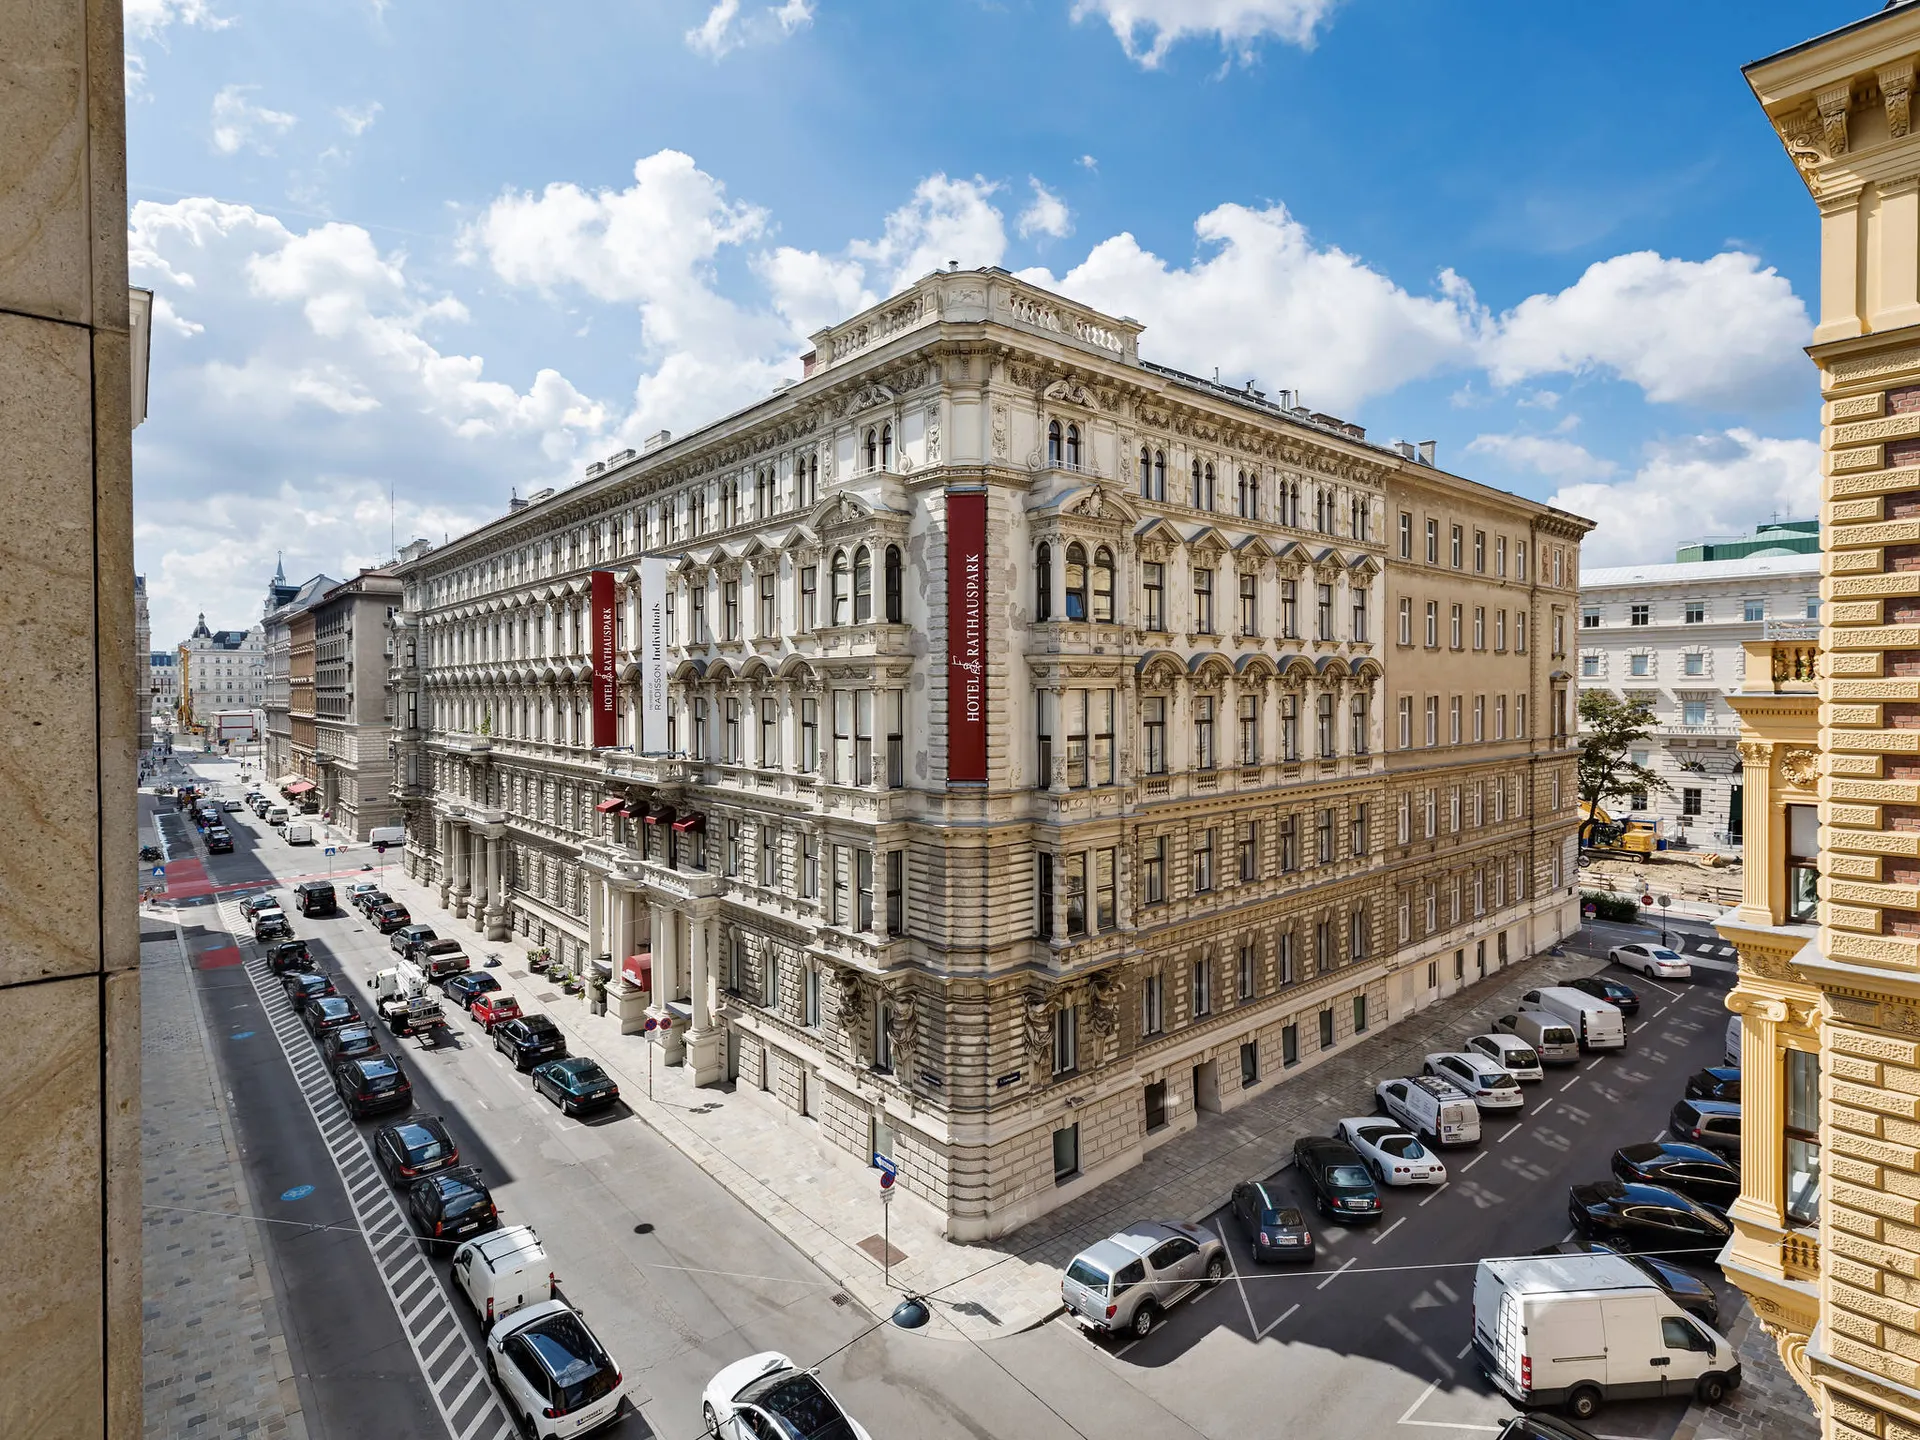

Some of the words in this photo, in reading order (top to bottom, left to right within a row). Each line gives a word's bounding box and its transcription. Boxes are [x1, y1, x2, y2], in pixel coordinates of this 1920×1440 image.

[966, 553, 980, 656] RATHAUSPARK
[603, 608, 612, 671] RATHAUSPARK
[604, 682, 613, 711] HOTEL
[967, 676, 979, 722] HOTEL
